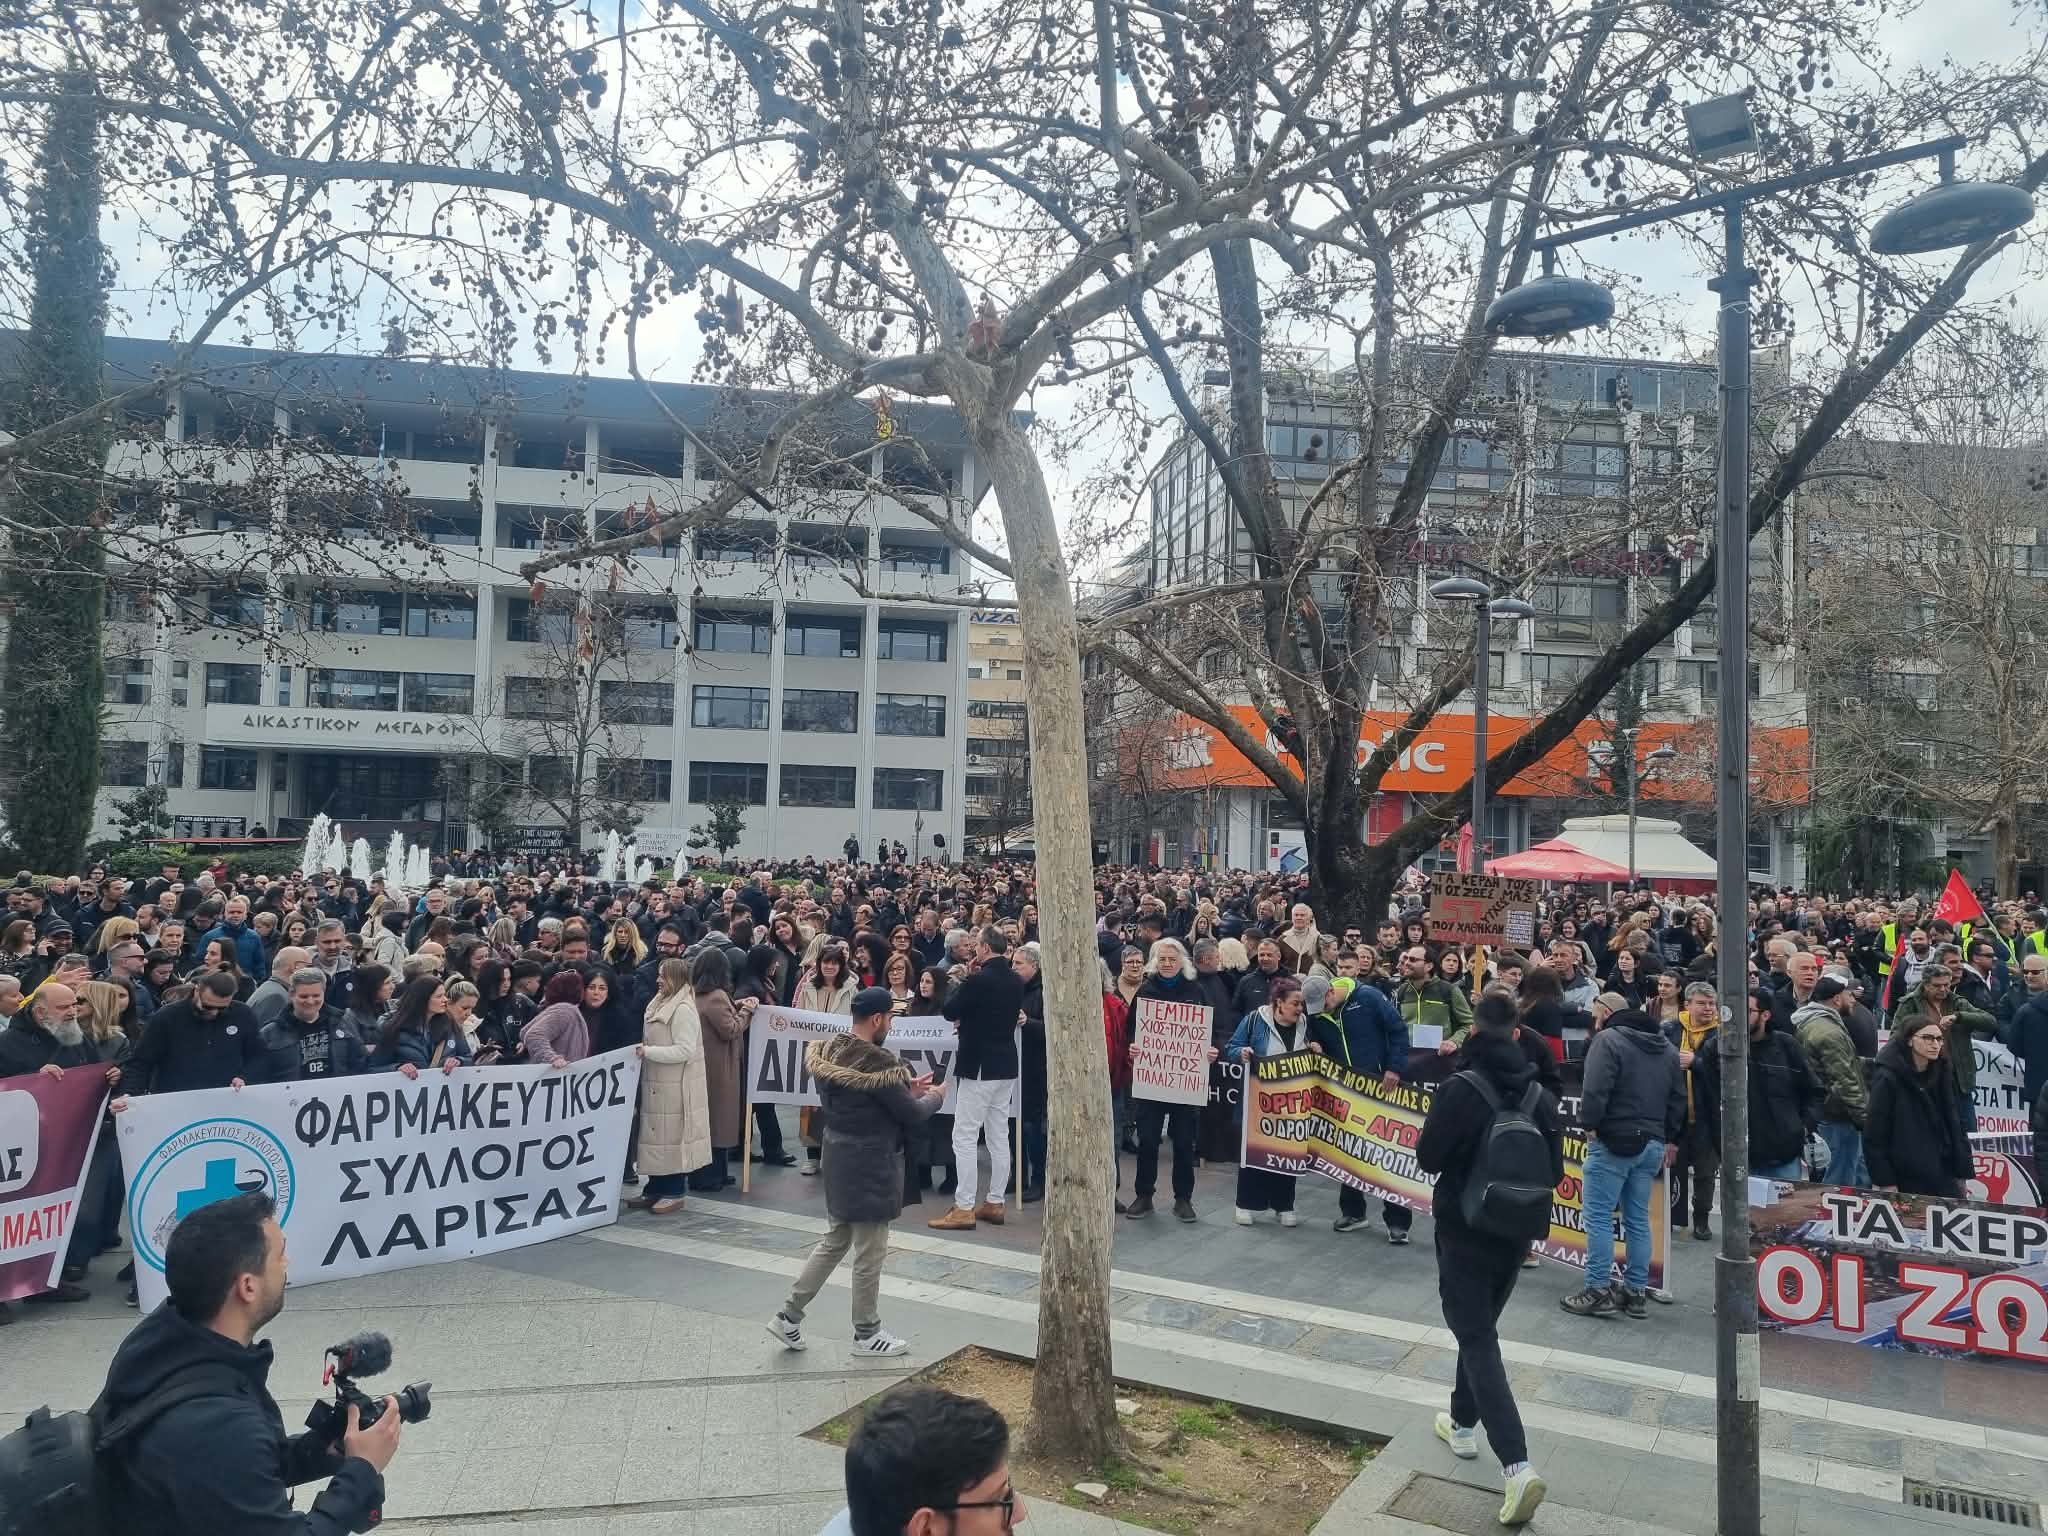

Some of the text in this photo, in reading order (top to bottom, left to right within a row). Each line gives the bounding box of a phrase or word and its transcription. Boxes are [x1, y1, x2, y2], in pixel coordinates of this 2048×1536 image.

[242, 713, 464, 737] ΔΙΚΑΣΤΙΚΟΝ ΜΕΓΑΡΟΝ
[1434, 872, 1455, 885] ΤΑ
[1462, 875, 1500, 889] ΚΕΡΔΗ
[1504, 879, 1534, 891] ΤΟΥΣ
[1462, 887, 1495, 899] ΖΩΕΣ
[1502, 889, 1535, 904] ΜΑΣ
[1432, 920, 1455, 931] ΠΟΥ
[1141, 998, 1205, 1025] ΤΕΜΠΗ
[904, 1028, 944, 1038] ΛΑΡΙΣΑΣ
[1142, 1035, 1204, 1058] ΒΙΟΛΑΝΤΑ
[1138, 1050, 1201, 1074] ΜΑΓΓΟΣ
[1258, 1061, 1278, 1081] ΑΝ
[1136, 1068, 1206, 1094] ΠΑΛΑΙΣΤΙΝΗ
[295, 1061, 626, 1148] ΦΑΡΜΑΚΕΥΤΙΚΟΣ
[1367, 1114, 1425, 1149] ΑΓΩ
[159, 1126, 242, 1160] ΦΑΡΜΑΚΕΥΤΙΚΟΣ
[243, 1131, 283, 1168] ΣΥΛΛΟΓΟΣ
[339, 1126, 595, 1203] ΣΥΛΛΟΓΟΣ
[1314, 1157, 1411, 1207] ΕΠΙΣΙΤΙΣΜΟΥ
[0, 1200, 72, 1251] ΜΑΤΙ
[321, 1175, 608, 1266] ΛΑΡΙΣΑΣ
[1824, 1195, 1908, 1247] ΤΑ
[1757, 1245, 1865, 1333] ΟΙ
